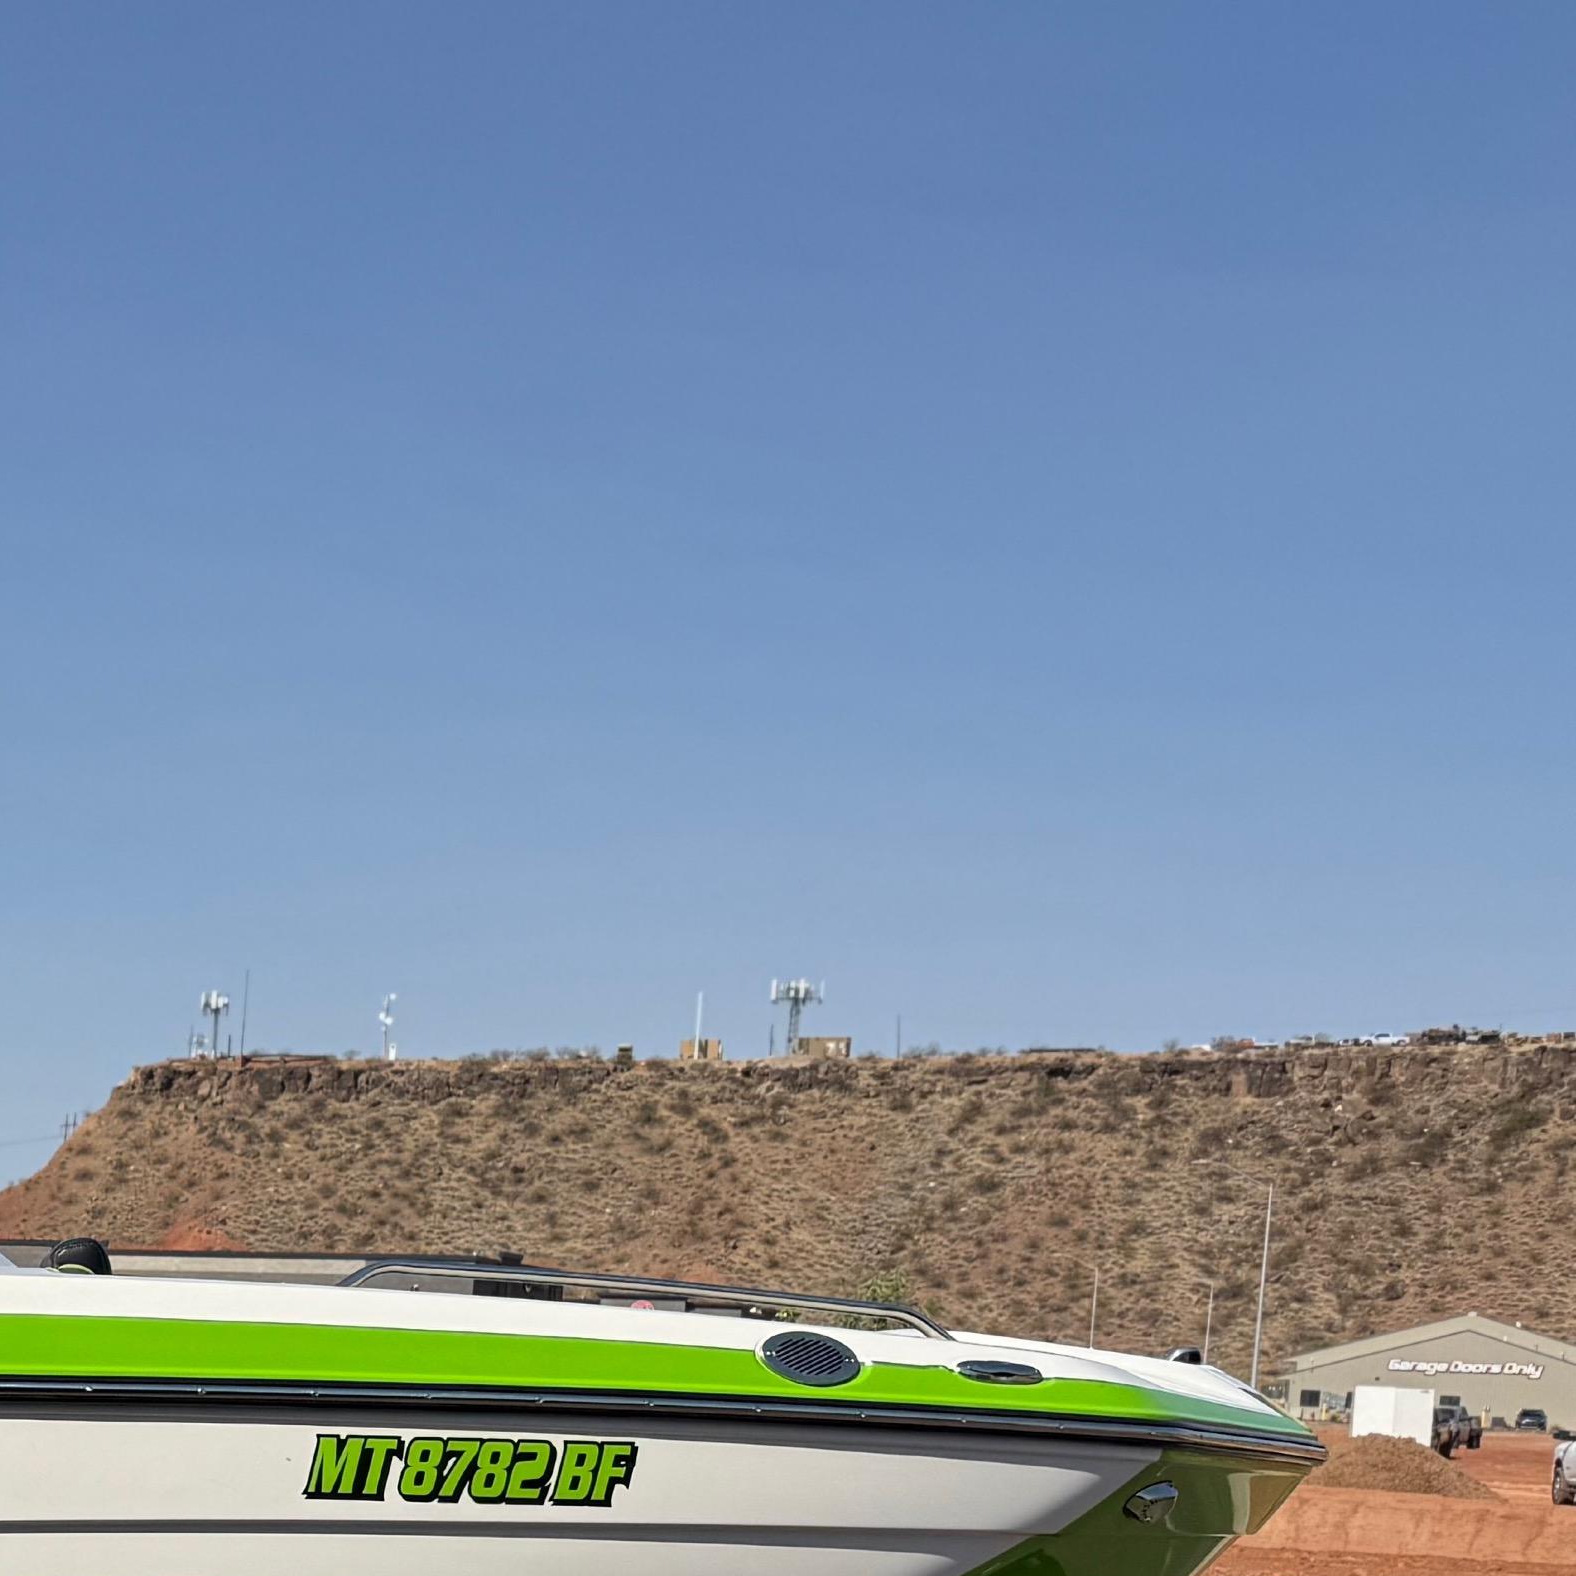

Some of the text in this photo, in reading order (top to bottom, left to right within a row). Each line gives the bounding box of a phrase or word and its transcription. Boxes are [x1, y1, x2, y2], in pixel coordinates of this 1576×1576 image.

[1388, 1359, 1545, 1379] Garage Doors Only
[302, 1434, 638, 1507] MT 8782 BF
